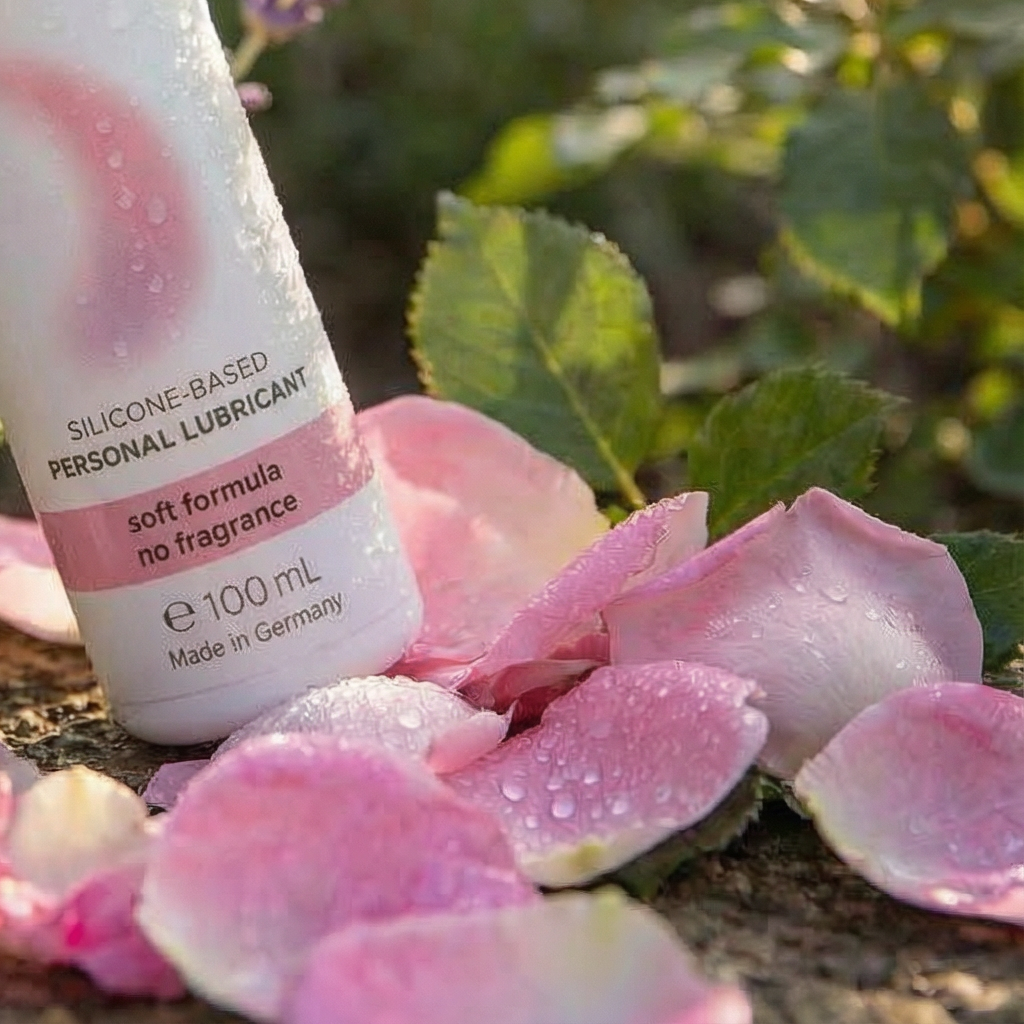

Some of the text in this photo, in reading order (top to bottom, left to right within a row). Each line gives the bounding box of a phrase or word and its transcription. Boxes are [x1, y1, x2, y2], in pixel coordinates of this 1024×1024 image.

[47, 366, 308, 480] PERSONAL LUBRICANT
[66, 351, 269, 441] SILICONE-BASED
[127, 462, 284, 534] soft formula
[137, 493, 299, 567] no fragrance
[202, 575, 268, 621] 100
[275, 557, 322, 598] mL
[168, 592, 343, 671] Made in Germany
